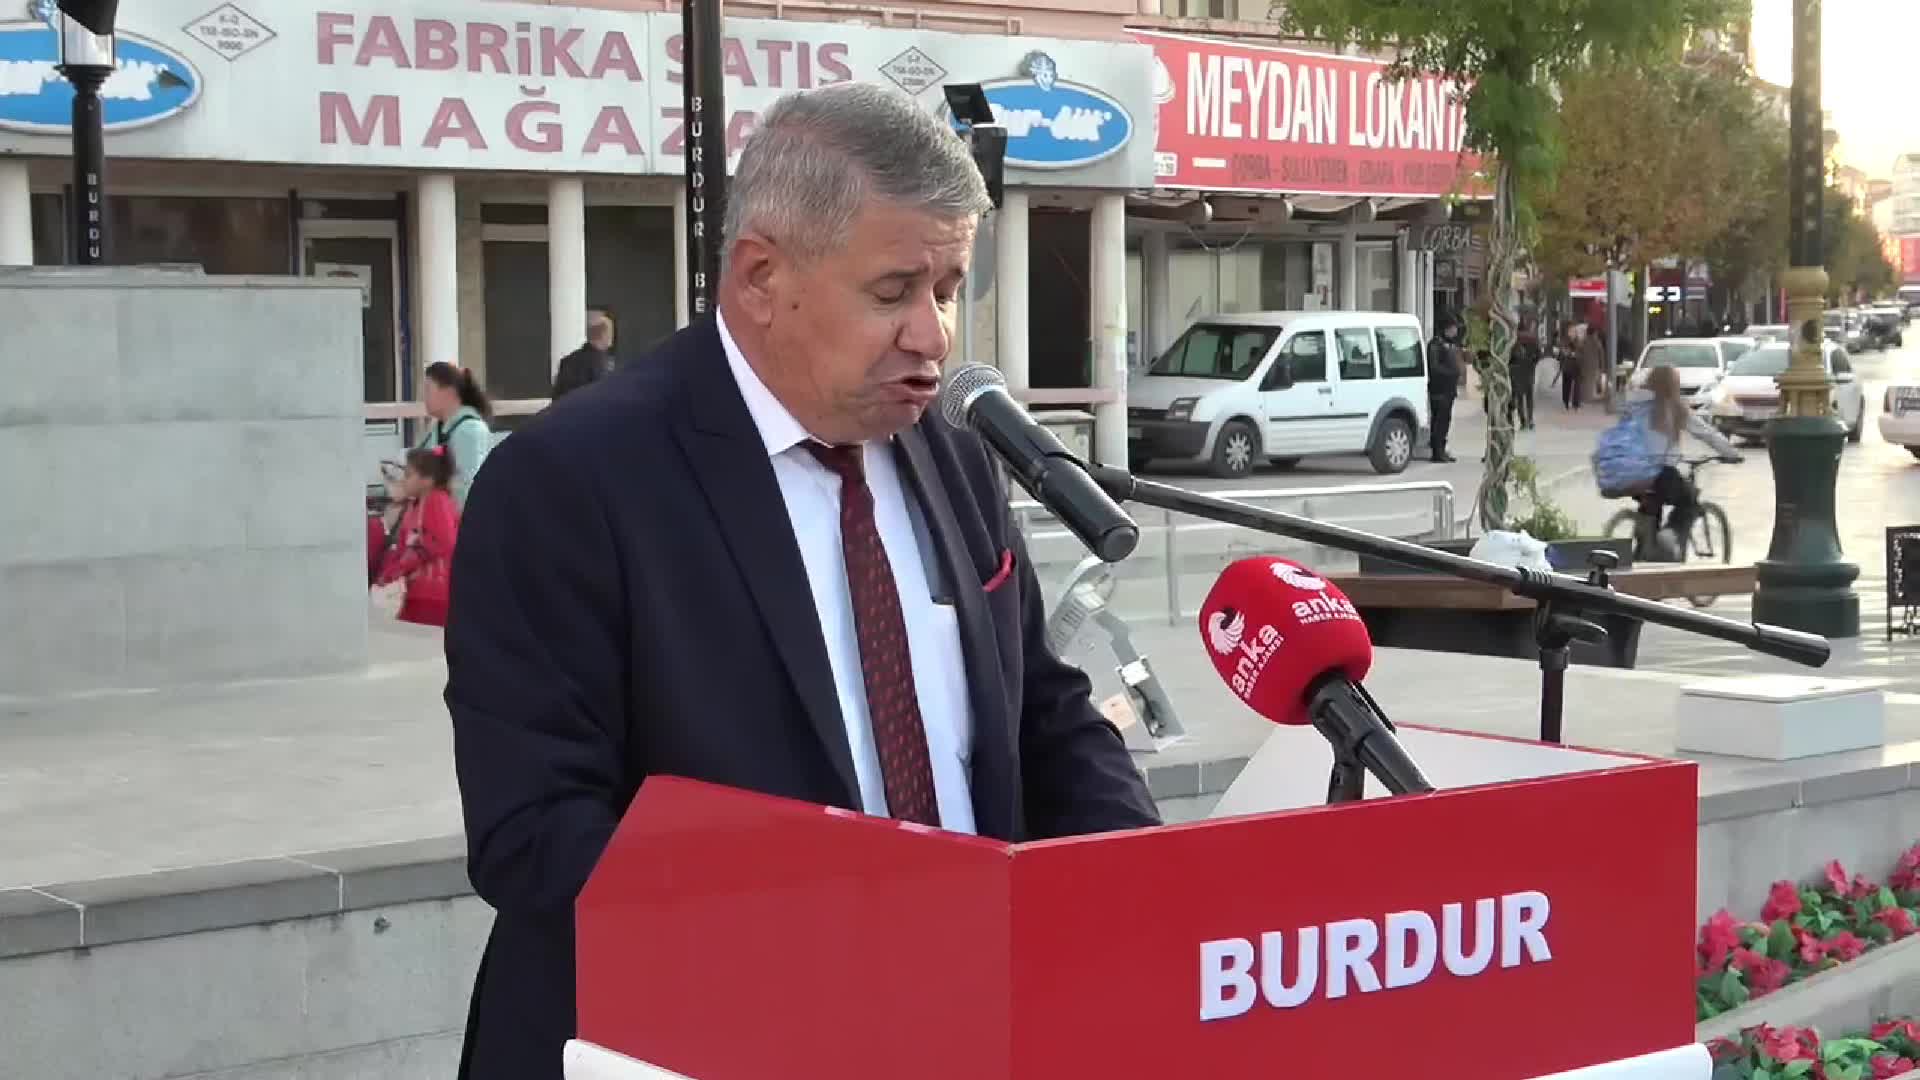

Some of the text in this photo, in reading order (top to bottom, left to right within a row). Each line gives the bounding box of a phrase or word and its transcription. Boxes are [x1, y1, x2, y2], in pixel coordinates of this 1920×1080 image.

[1186, 51, 1338, 145] MEYDAN
[691, 96, 705, 238] BURDUR
[1291, 591, 1358, 617] anka
[1231, 624, 1279, 694] anka
[1198, 889, 1553, 1023] BURDUR
